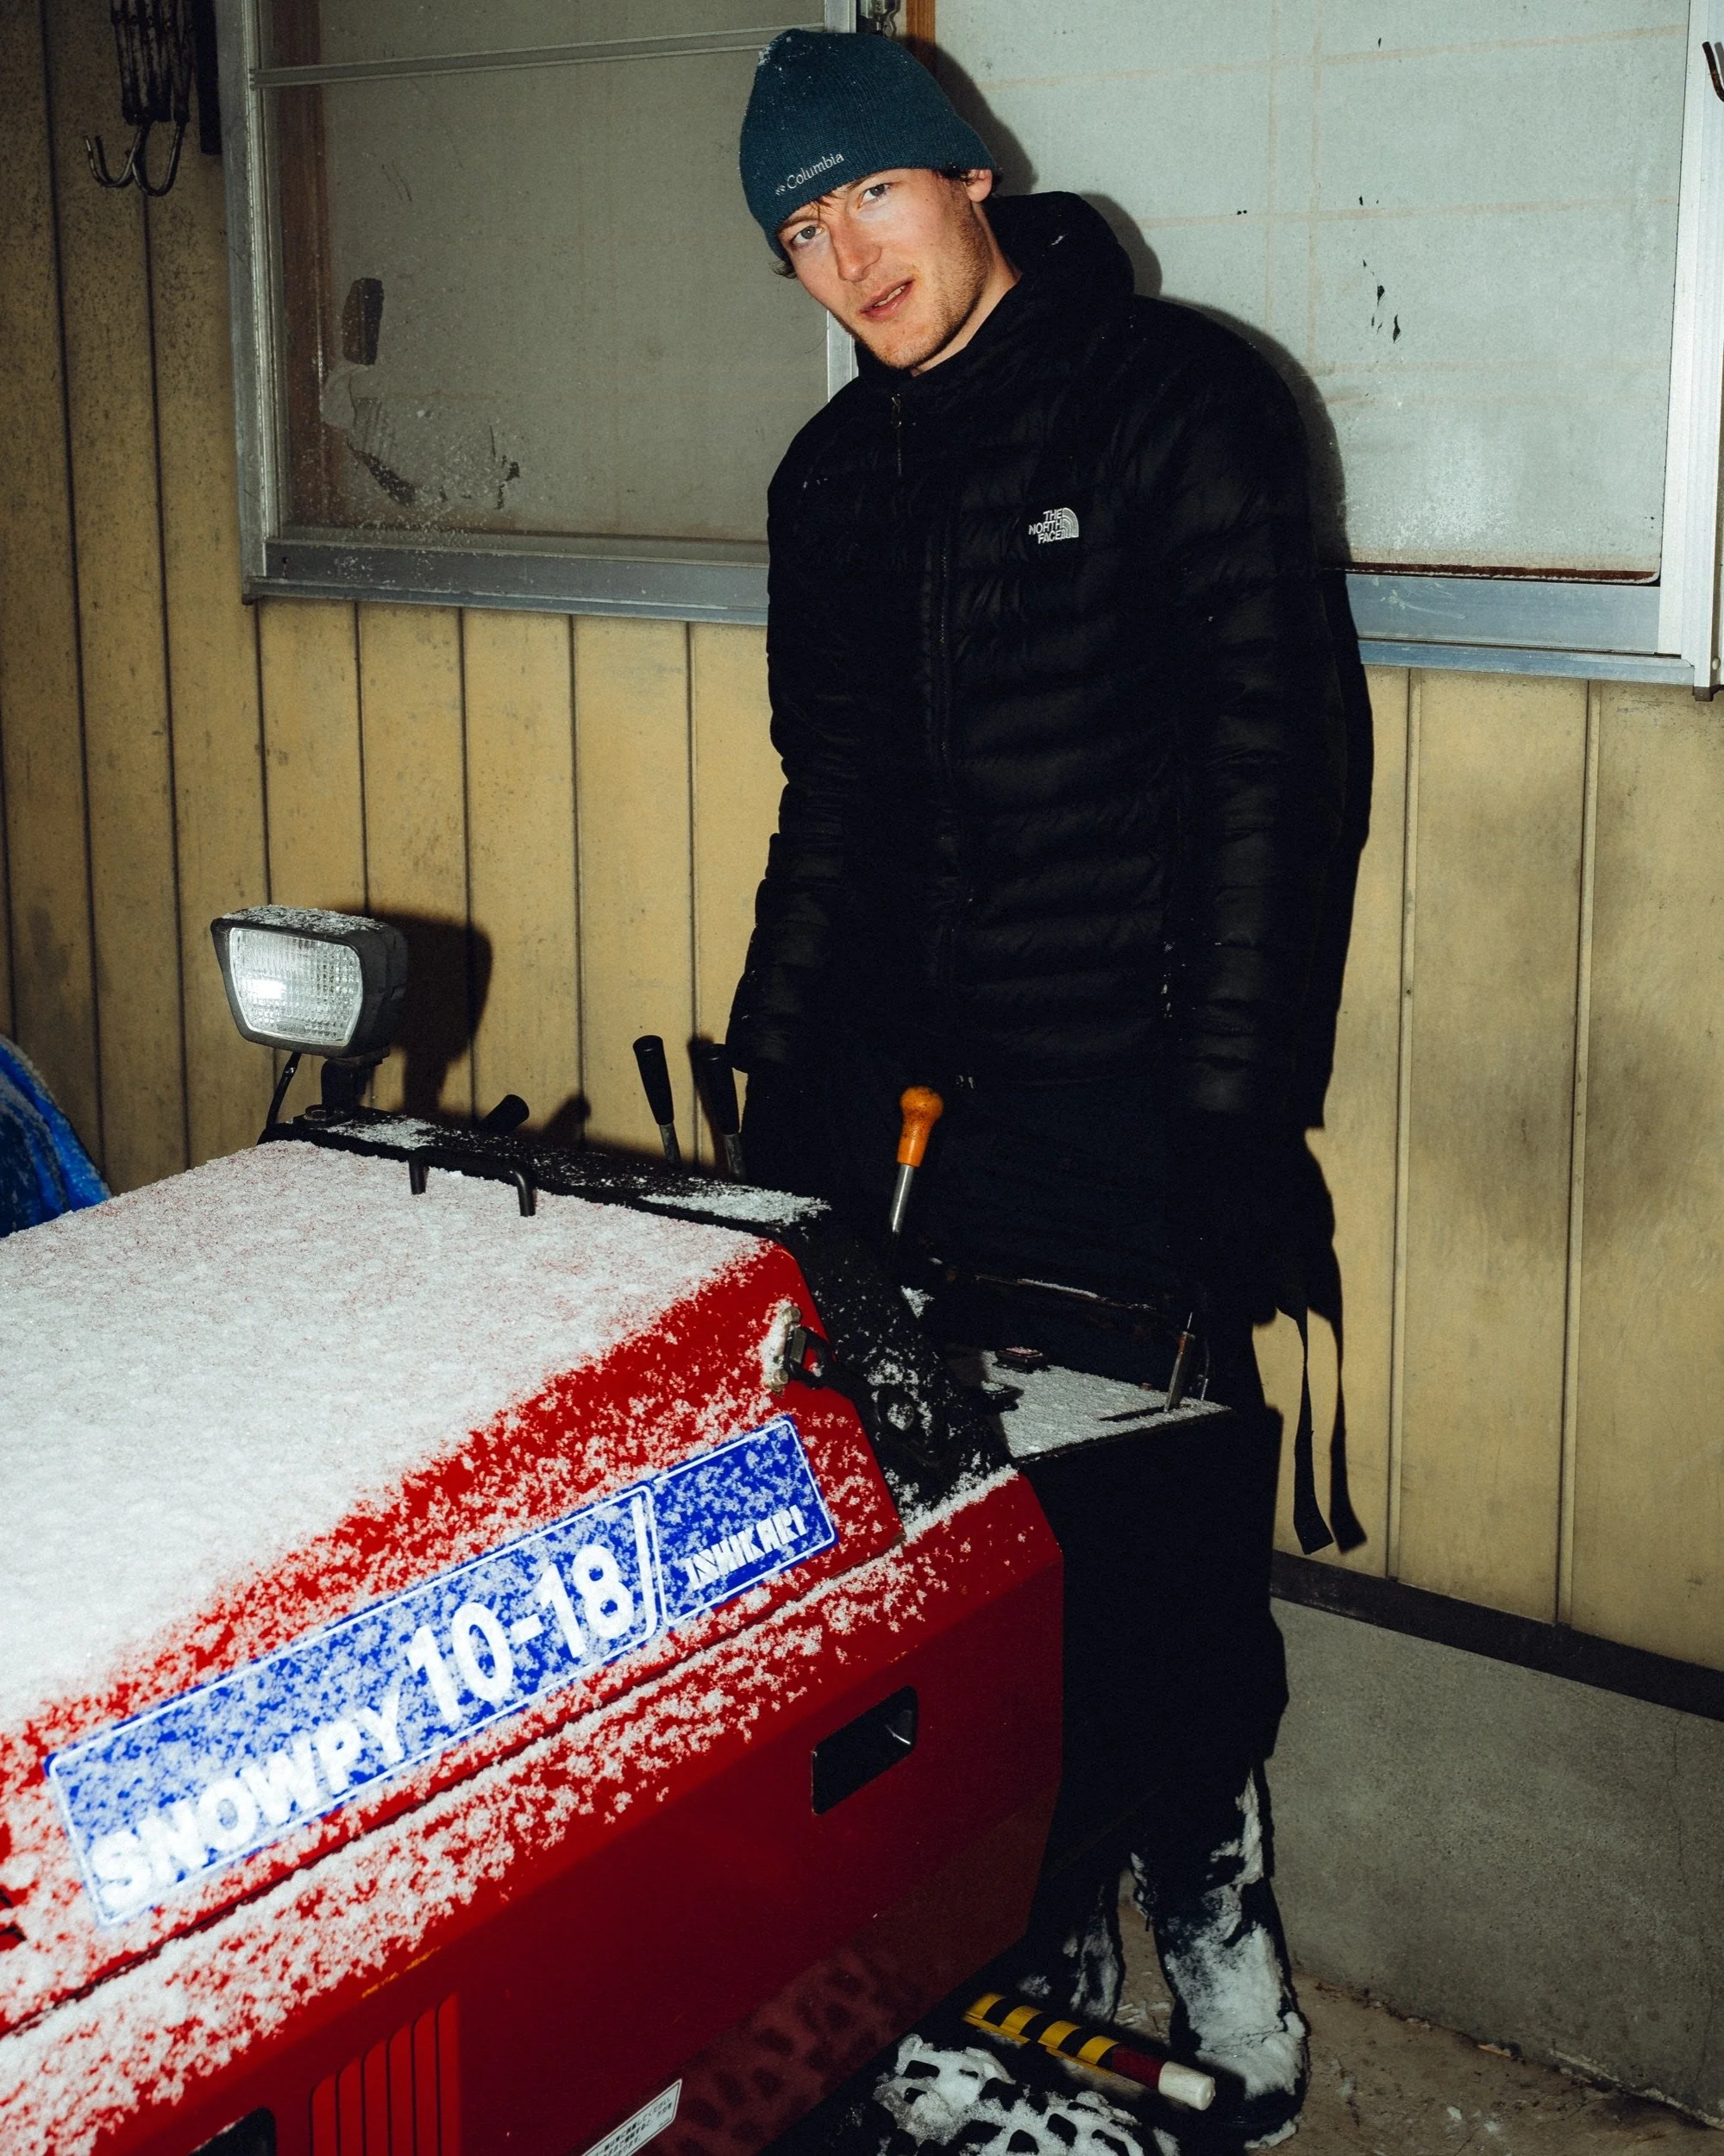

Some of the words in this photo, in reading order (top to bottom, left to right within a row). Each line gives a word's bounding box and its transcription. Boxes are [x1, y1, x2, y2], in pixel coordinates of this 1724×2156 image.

[787, 154, 844, 189] Columbia
[1043, 509, 1063, 521] THE
[1028, 519, 1063, 535] NORTH
[1038, 530, 1062, 544] FACE
[90, 1685, 404, 1908] SNOWPY
[406, 1545, 634, 1723] 10-18
